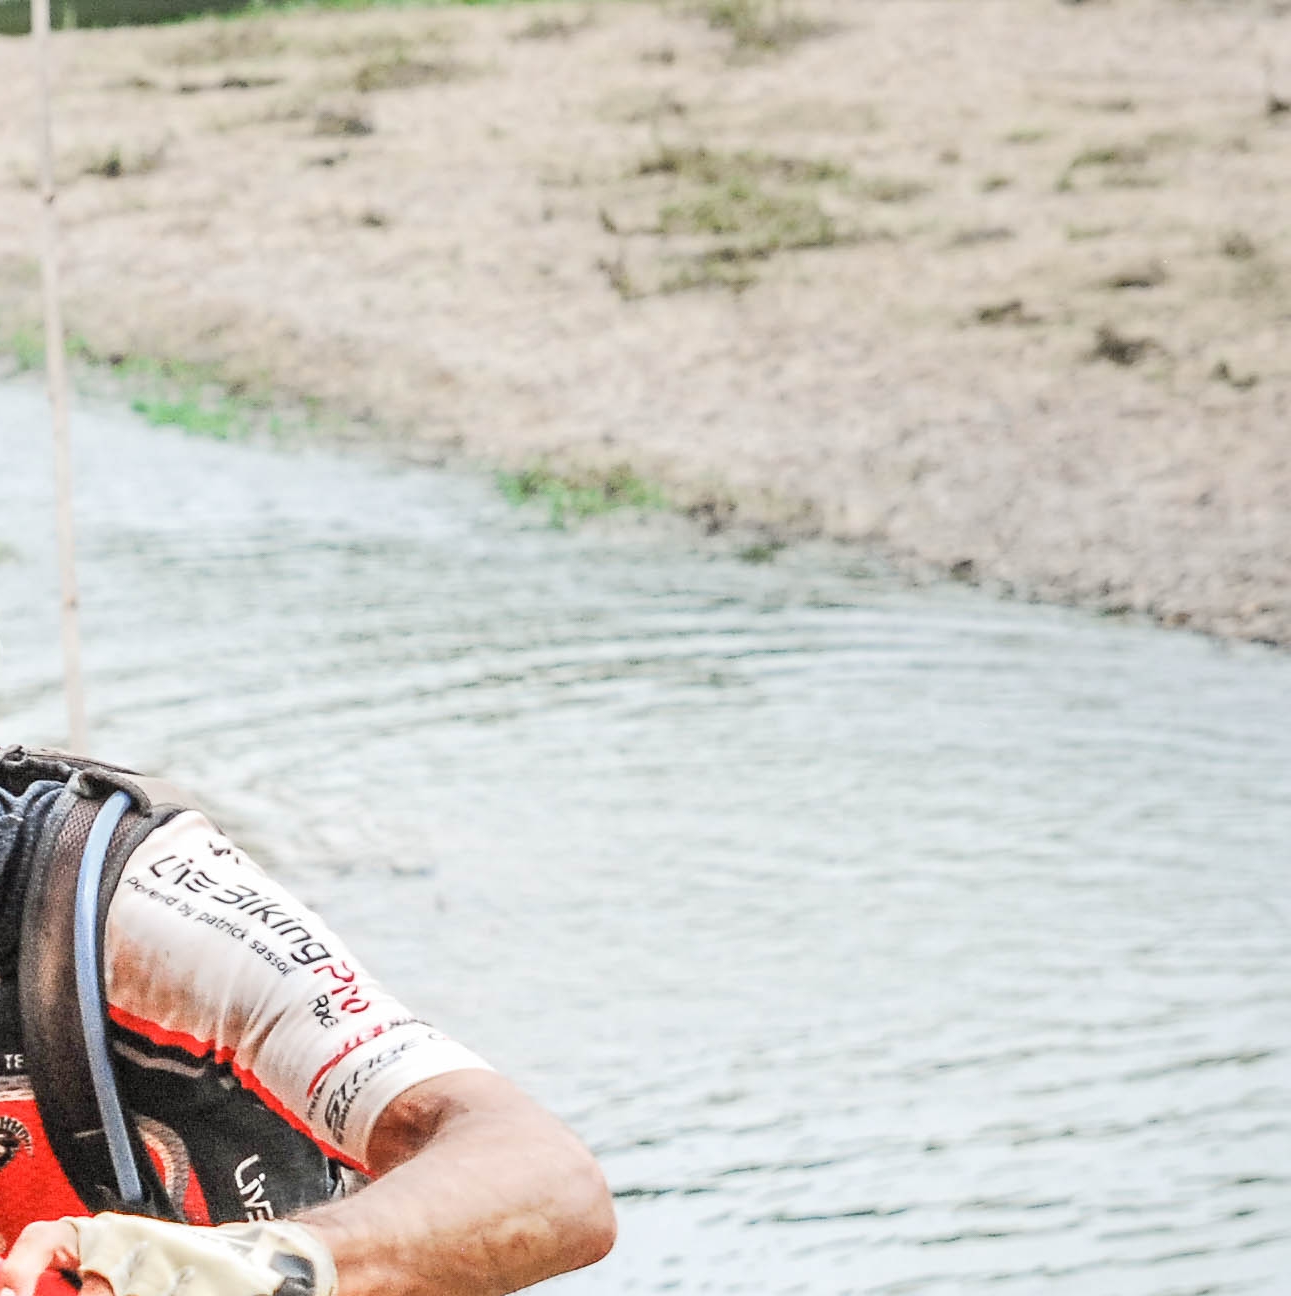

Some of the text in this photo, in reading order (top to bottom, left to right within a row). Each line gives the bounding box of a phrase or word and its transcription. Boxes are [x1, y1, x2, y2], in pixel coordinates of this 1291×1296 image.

[178, 900, 198, 917] by
[196, 911, 250, 941] patrick
[4, 1053, 25, 1070] TE
